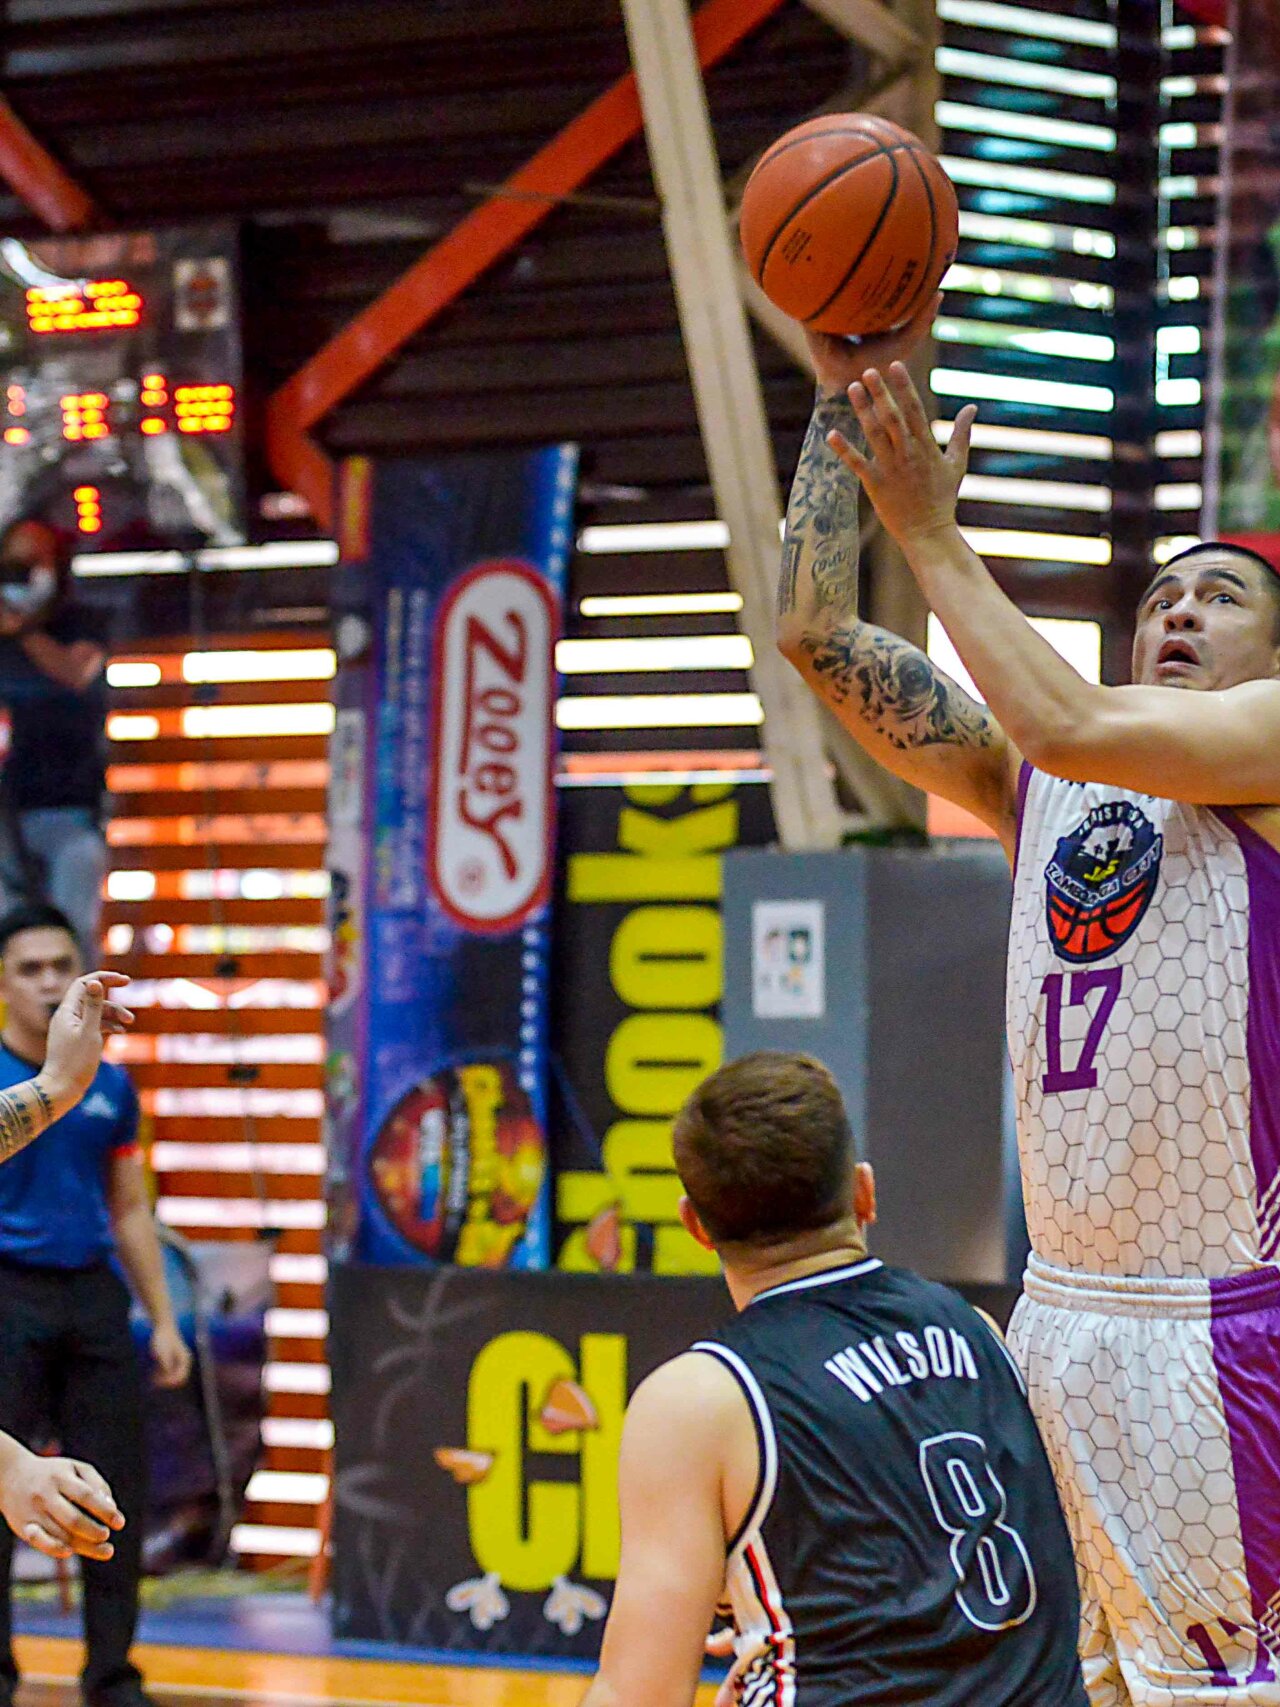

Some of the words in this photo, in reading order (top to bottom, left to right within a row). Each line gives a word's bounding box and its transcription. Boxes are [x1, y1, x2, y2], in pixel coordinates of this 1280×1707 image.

[1040, 965, 1123, 1094] 17
[824, 1324, 979, 1403] WILSON
[919, 1431, 1037, 1632] 8
